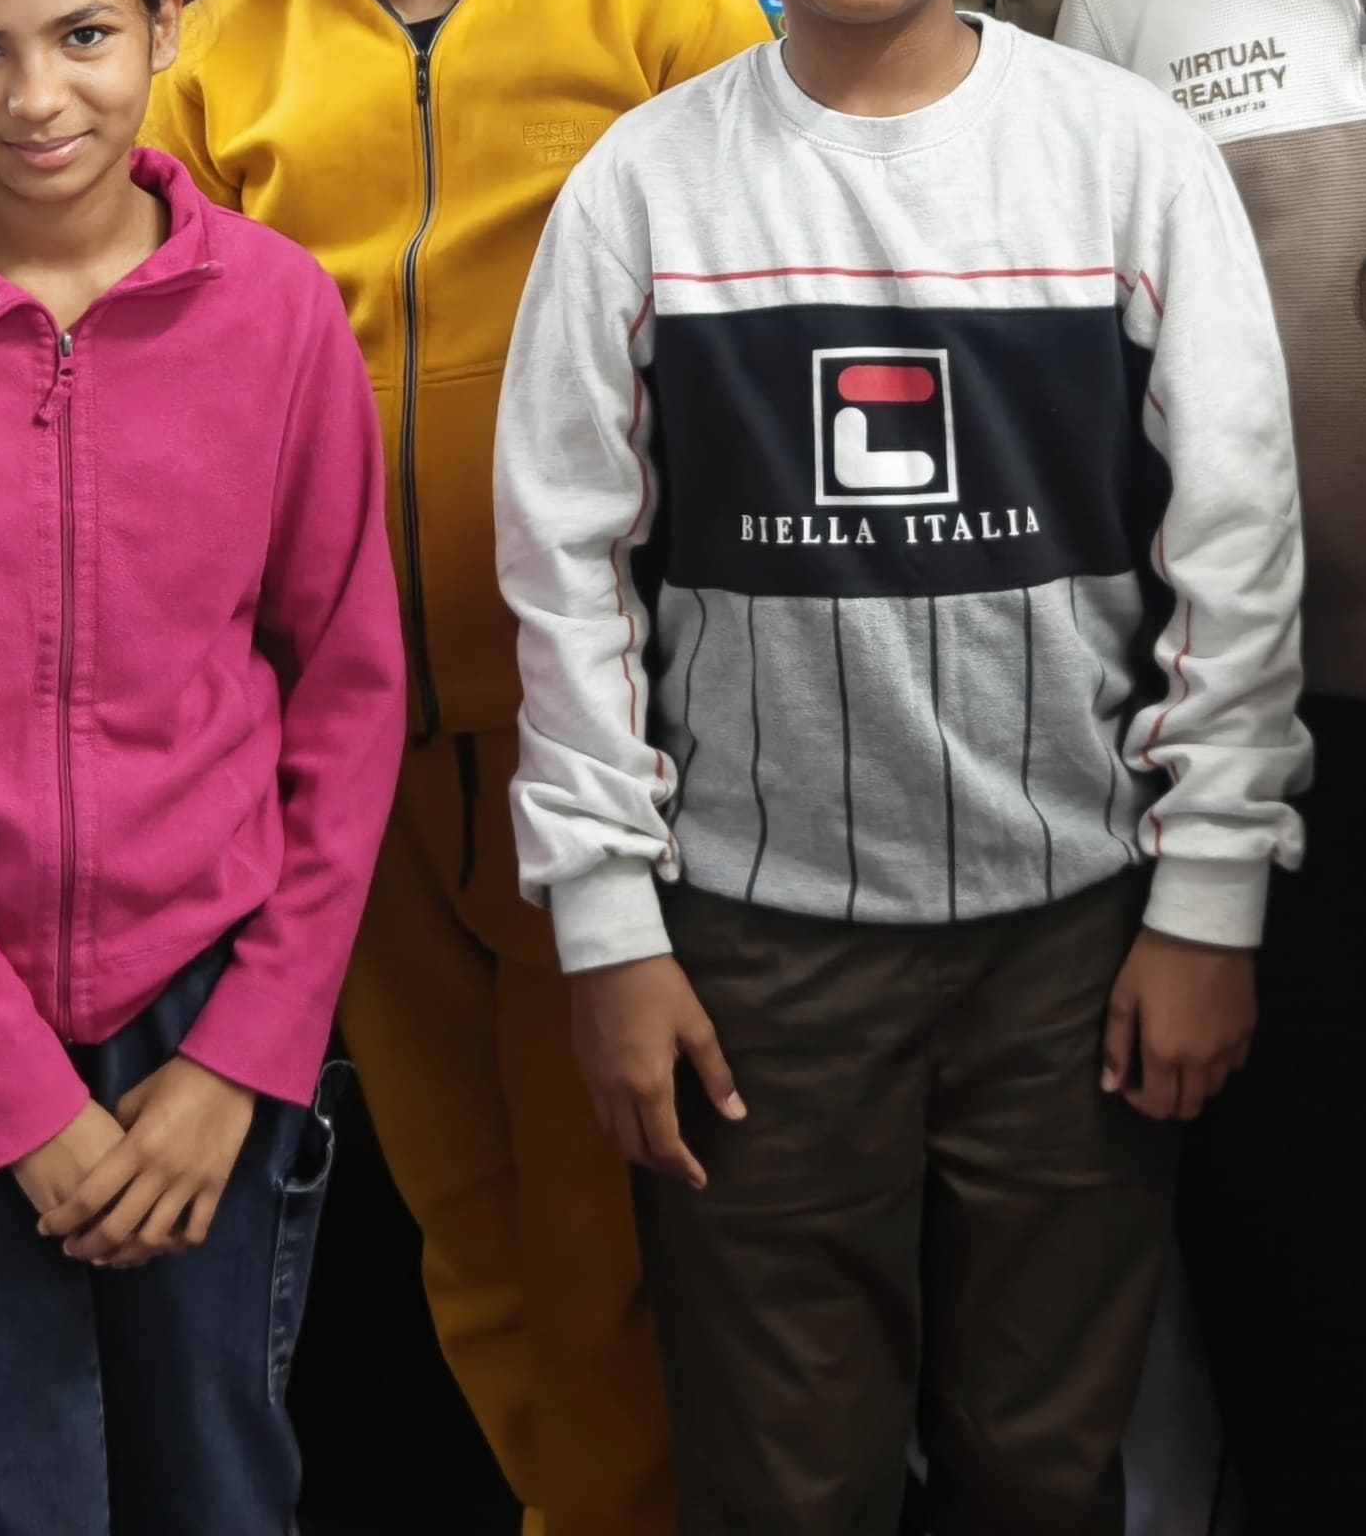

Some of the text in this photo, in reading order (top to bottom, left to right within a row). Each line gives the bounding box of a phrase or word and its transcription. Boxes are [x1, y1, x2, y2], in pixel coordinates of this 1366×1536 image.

[1169, 37, 1285, 83] VIRTUAL
[741, 506, 1040, 544] BIELLA ITALIA
